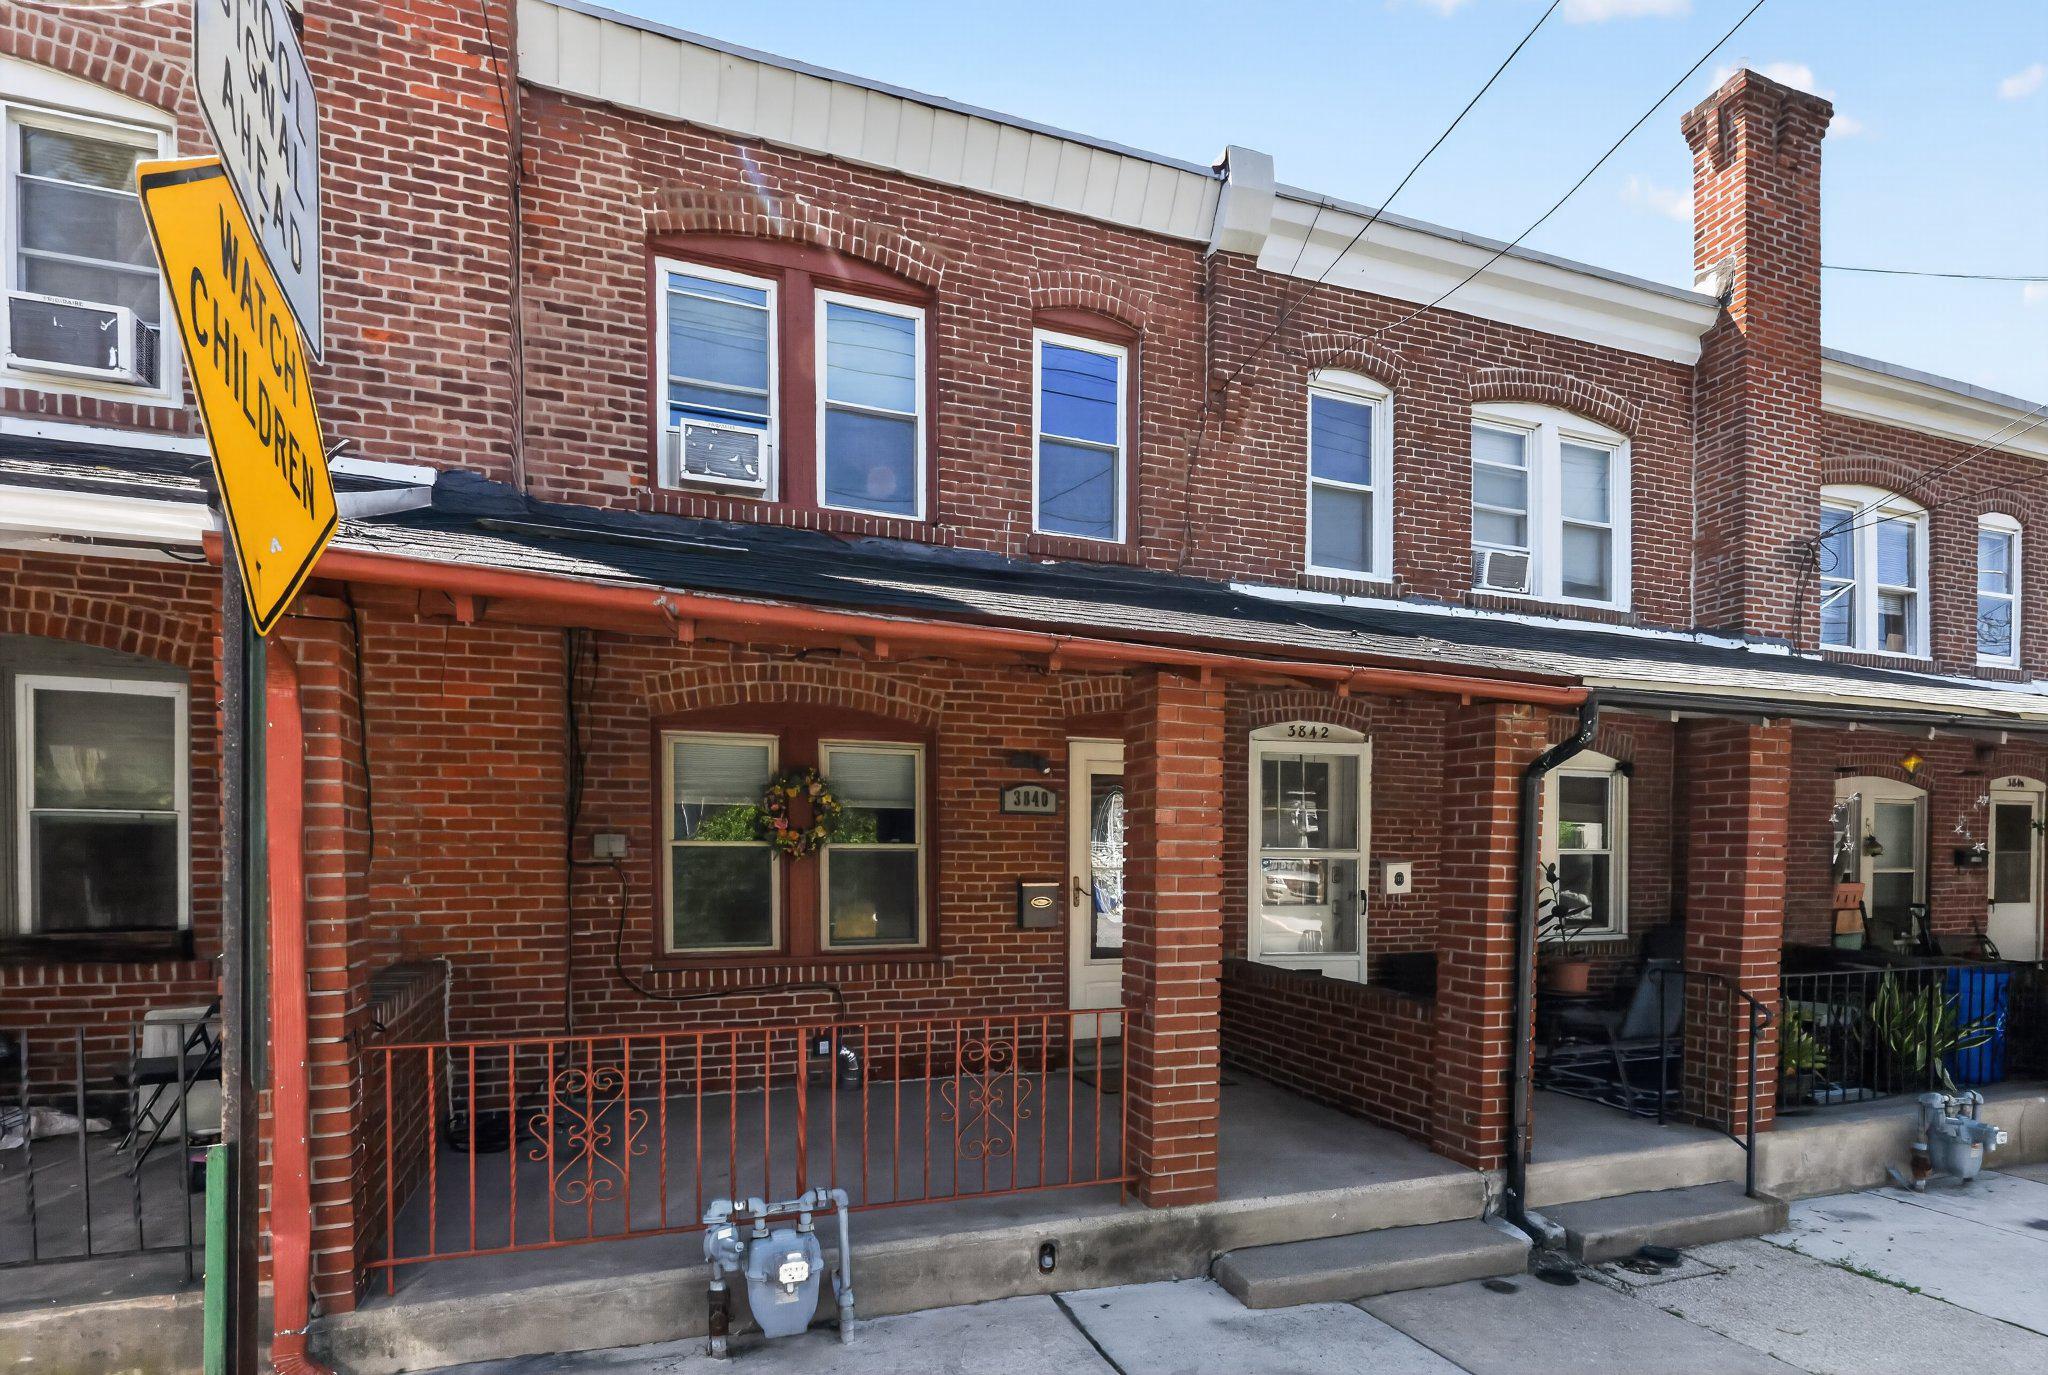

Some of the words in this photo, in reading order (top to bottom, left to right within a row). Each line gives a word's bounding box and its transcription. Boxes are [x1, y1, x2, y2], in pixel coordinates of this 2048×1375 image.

[221, 0, 304, 211] IGNAL
[222, 56, 301, 275] AHEAD
[190, 266, 314, 520] CHILDREN
[218, 204, 296, 406] WATCH
[1013, 790, 1049, 807] 3840
[1287, 725, 1329, 739] 3842
